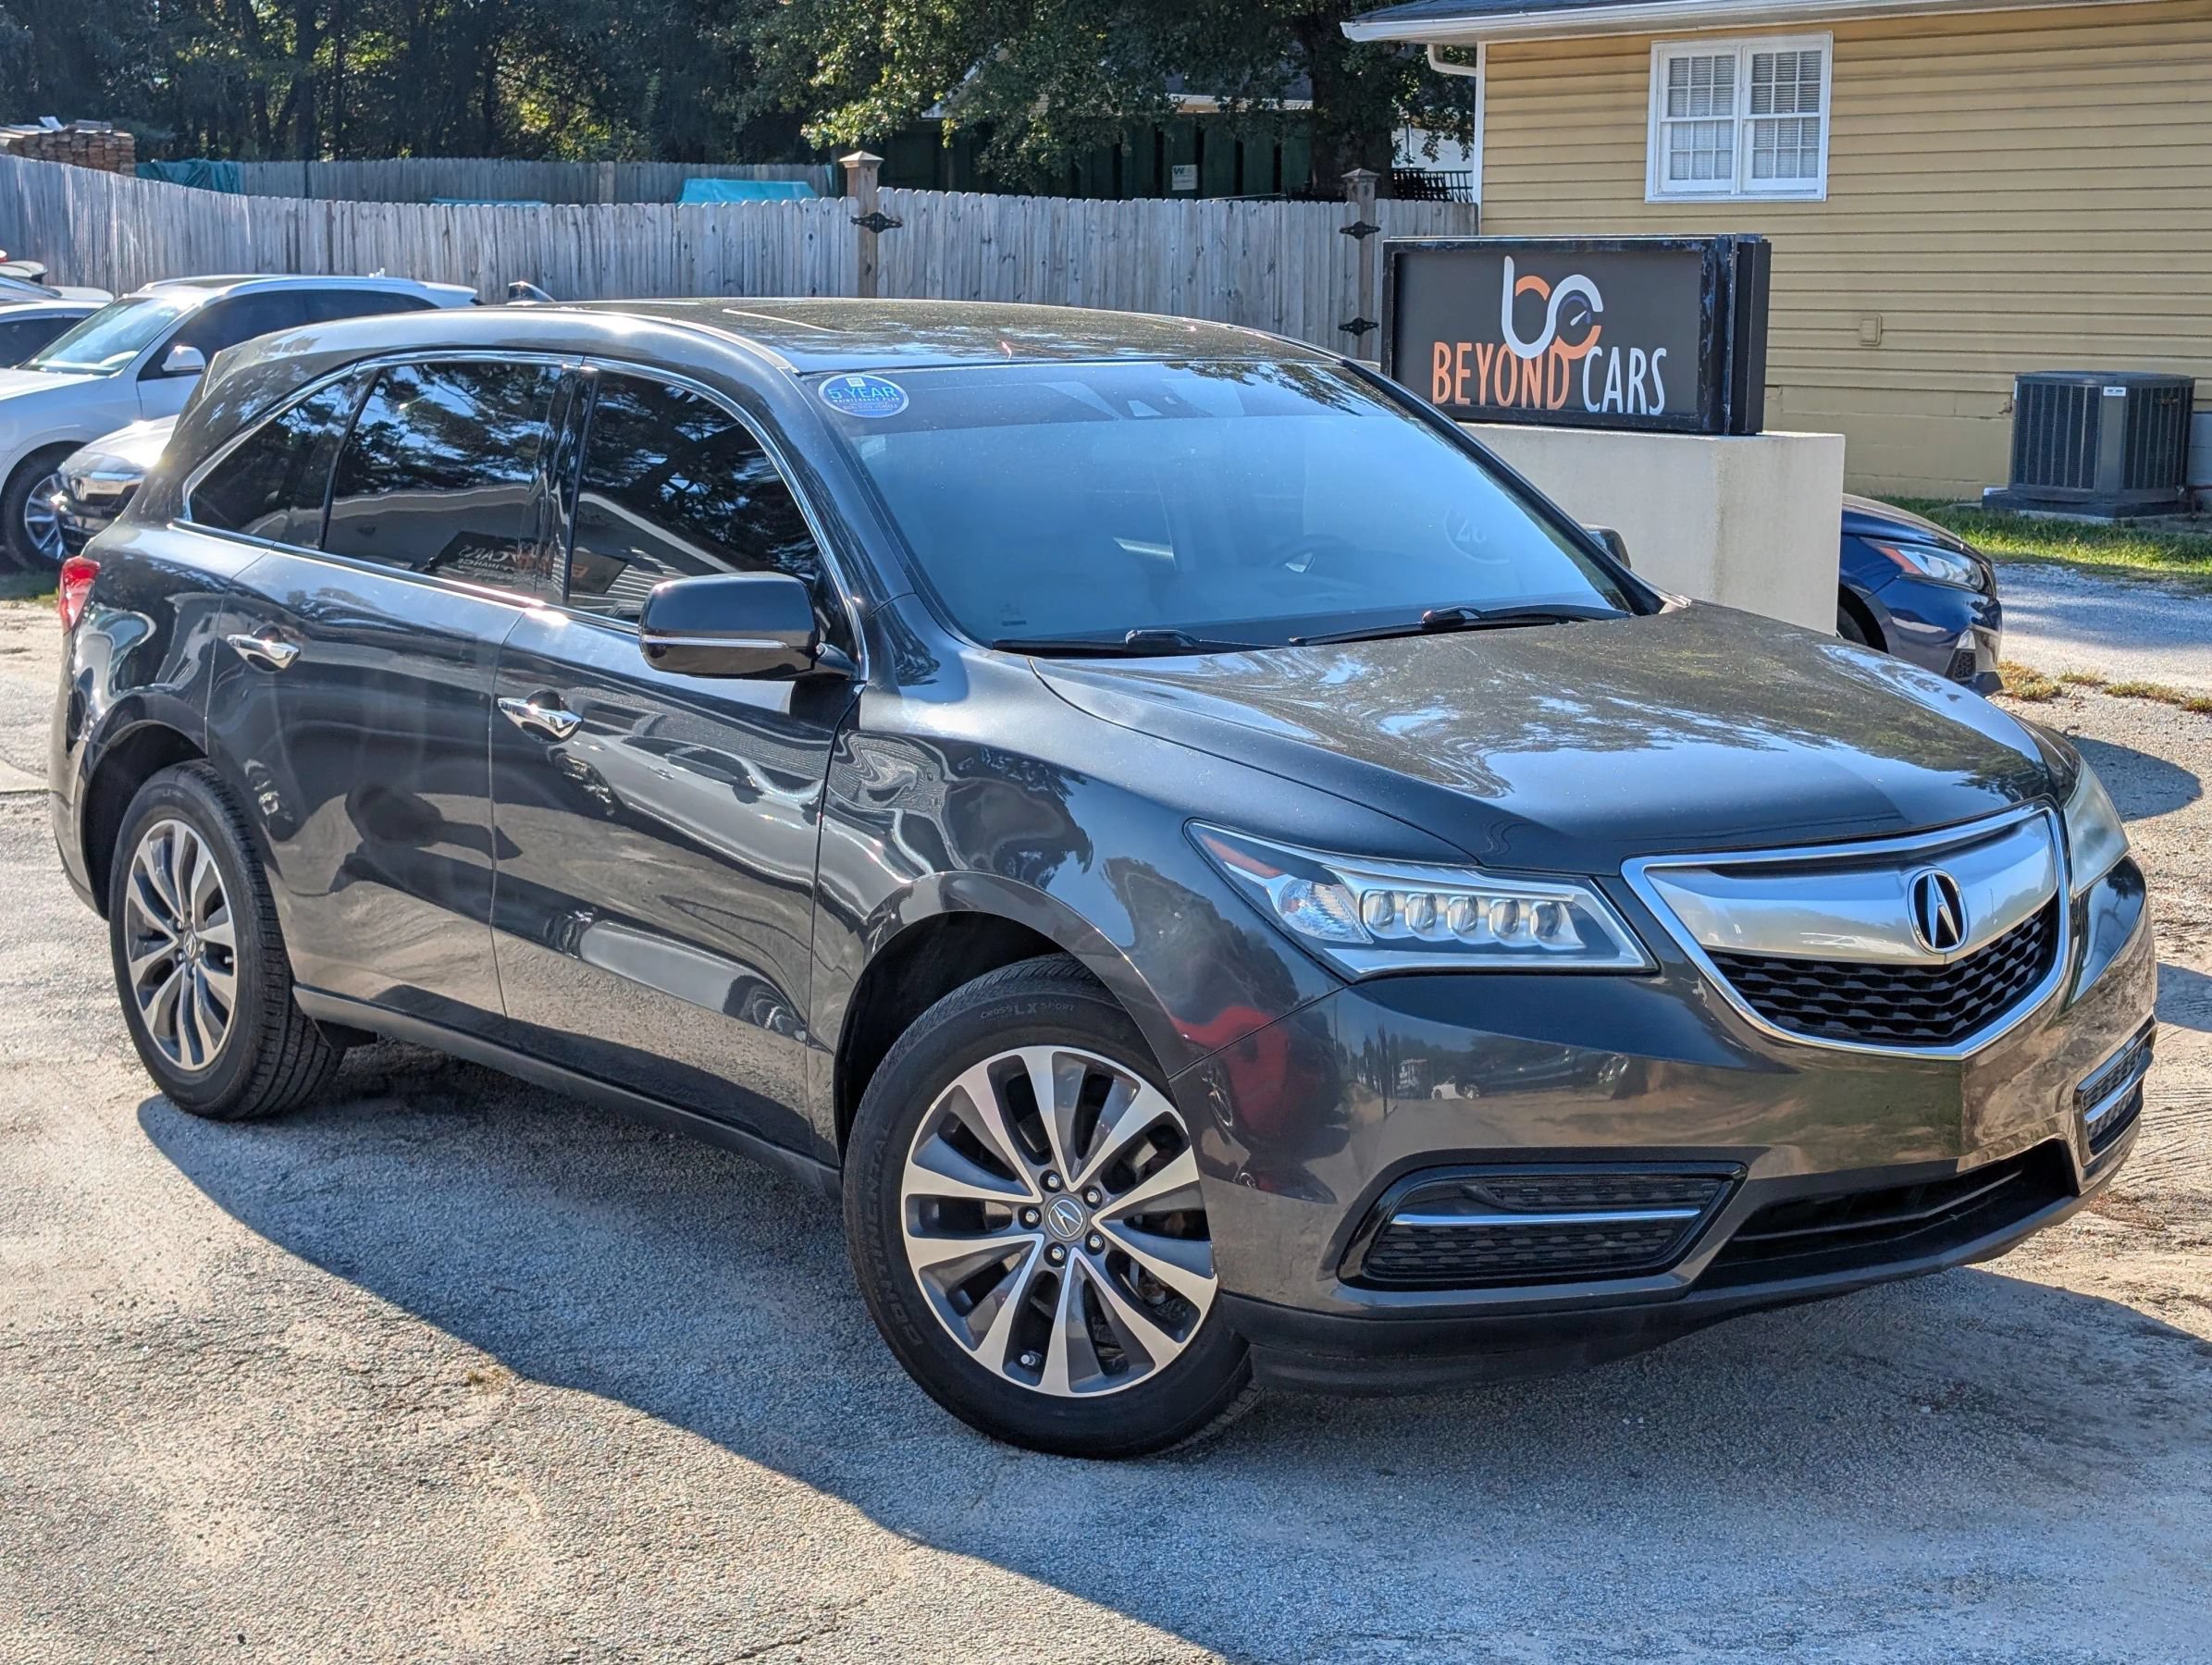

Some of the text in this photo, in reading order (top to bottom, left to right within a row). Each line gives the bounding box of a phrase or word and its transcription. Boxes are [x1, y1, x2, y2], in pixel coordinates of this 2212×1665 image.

[827, 386, 897, 400] 5 YEAR
[1432, 341, 1667, 415] BEYOND CARS
